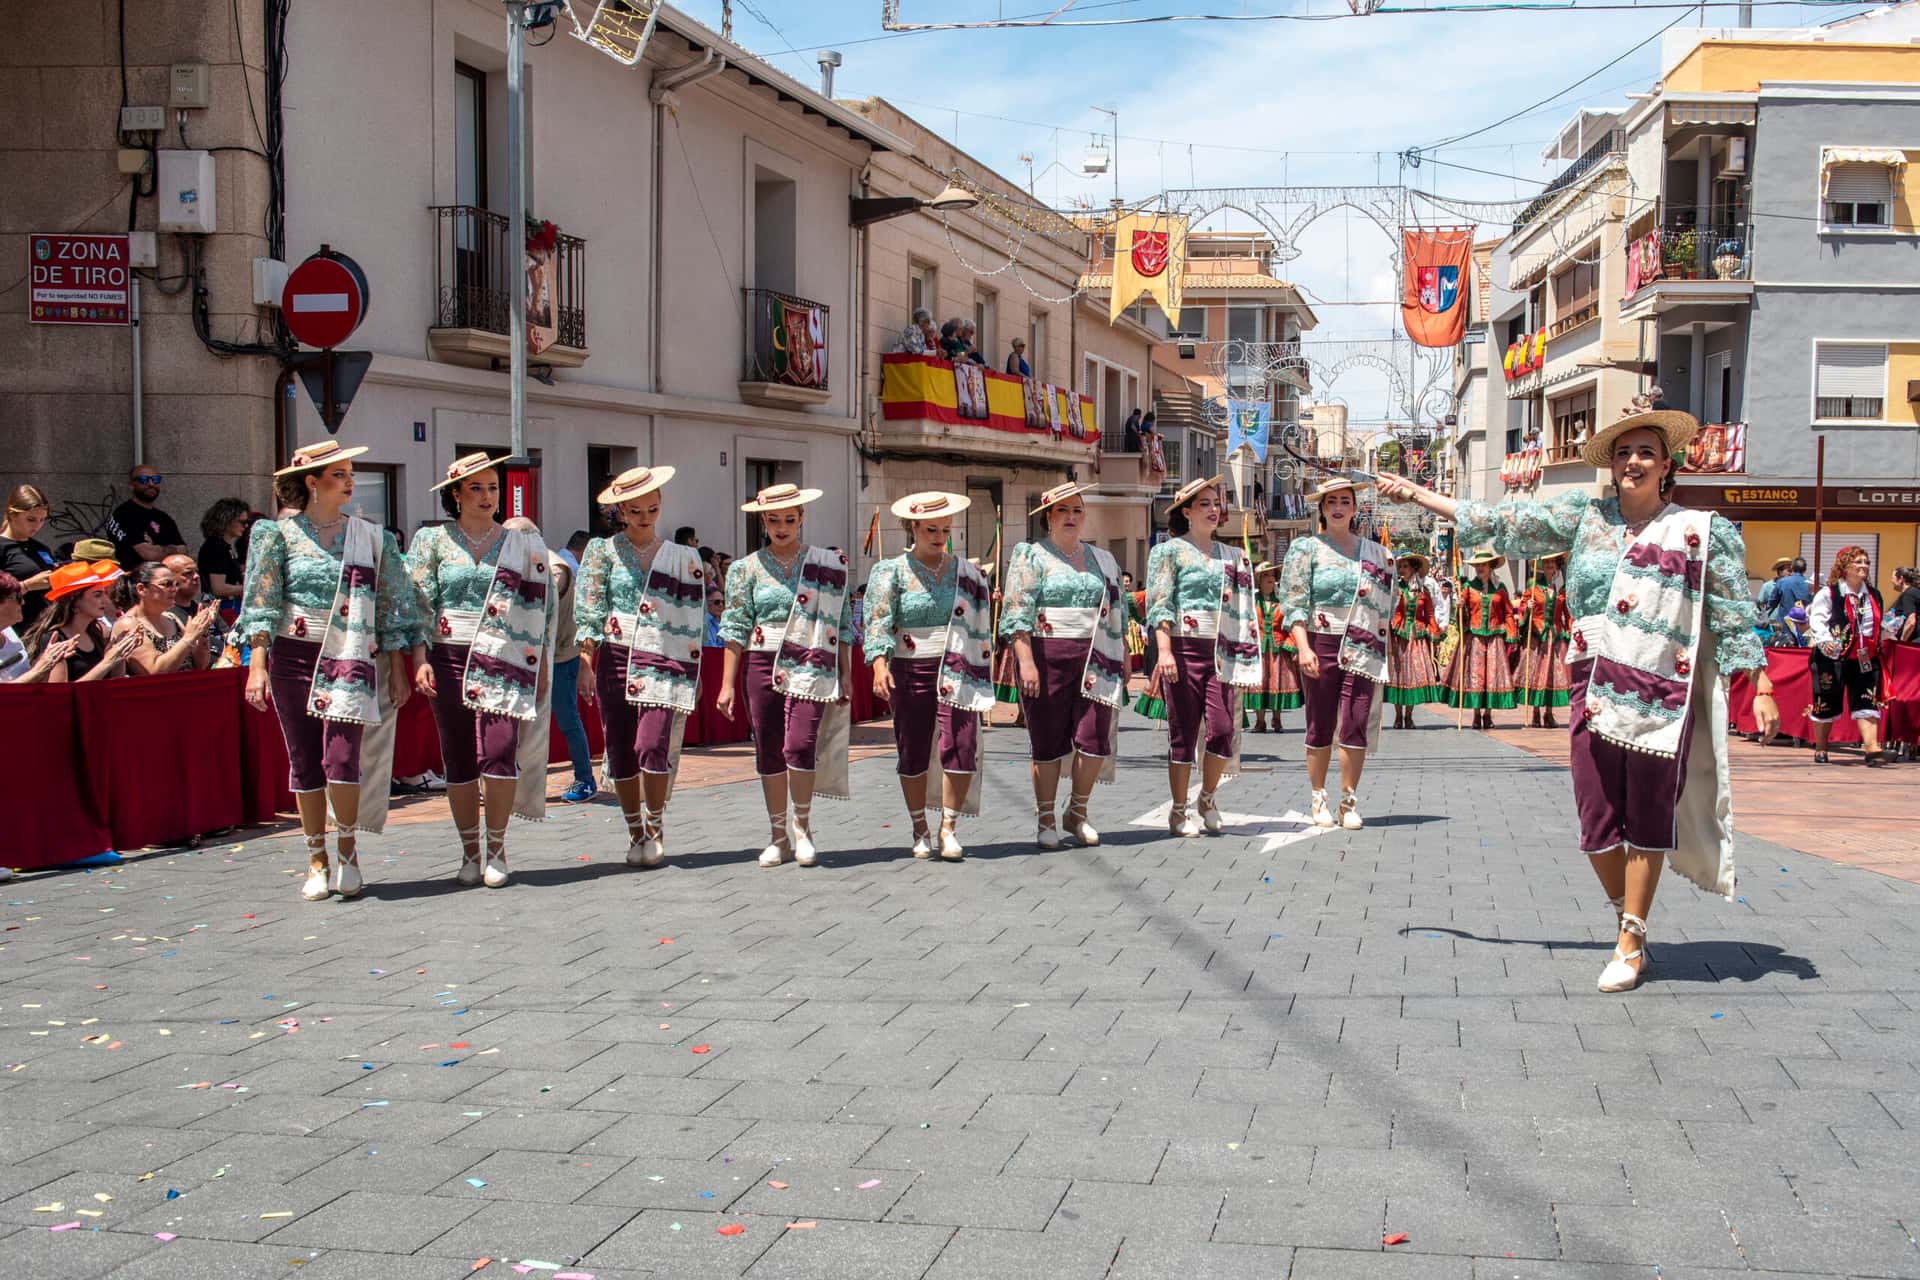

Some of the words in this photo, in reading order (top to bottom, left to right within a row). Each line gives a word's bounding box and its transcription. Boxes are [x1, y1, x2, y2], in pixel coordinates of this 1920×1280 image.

[58, 242, 120, 260] ZONA
[33, 265, 63, 284] DE
[70, 267, 125, 285] TIRO
[99, 292, 122, 301] FUMES
[1743, 489, 1798, 500] ESTANCO
